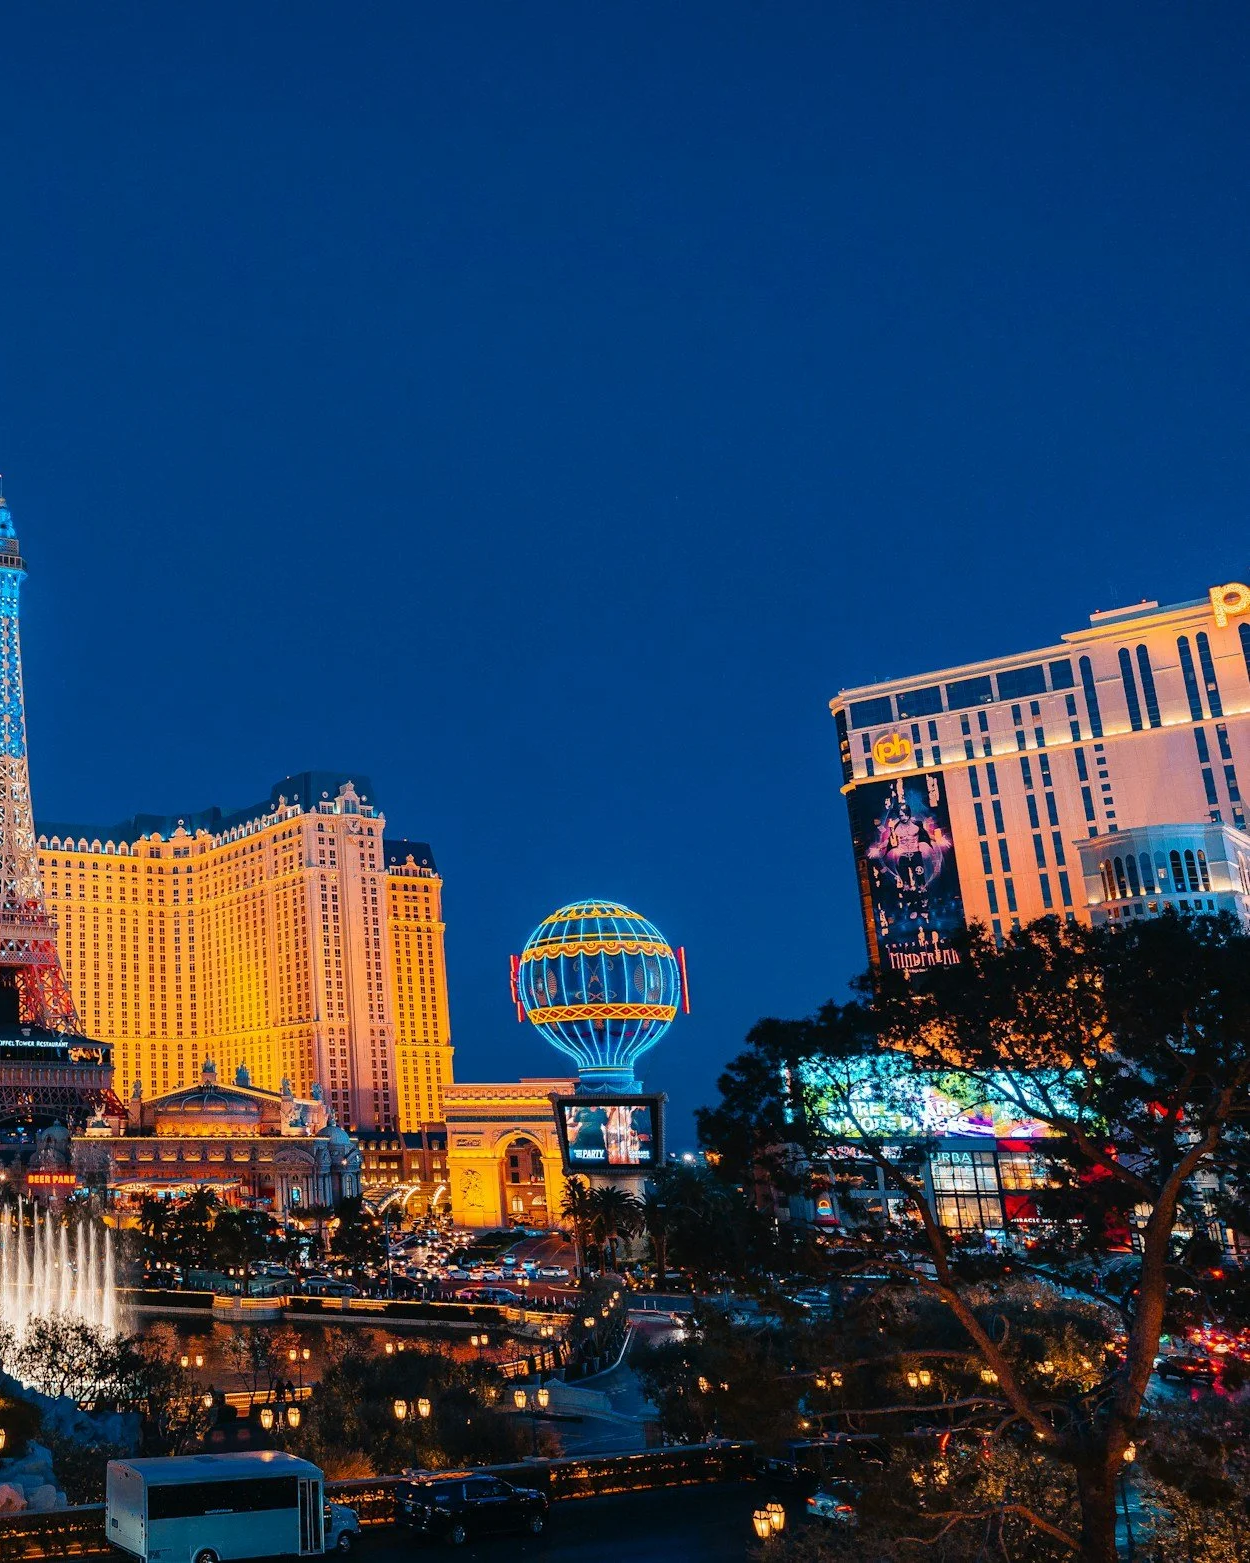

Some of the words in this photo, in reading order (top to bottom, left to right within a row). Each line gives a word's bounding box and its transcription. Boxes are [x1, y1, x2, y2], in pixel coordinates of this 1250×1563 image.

[877, 733, 911, 763] ph
[36, 1040, 69, 1048] RESTAURANT
[582, 1149, 605, 1159] PARTY
[28, 1174, 51, 1184] BEER
[52, 1174, 76, 1184] PARK
